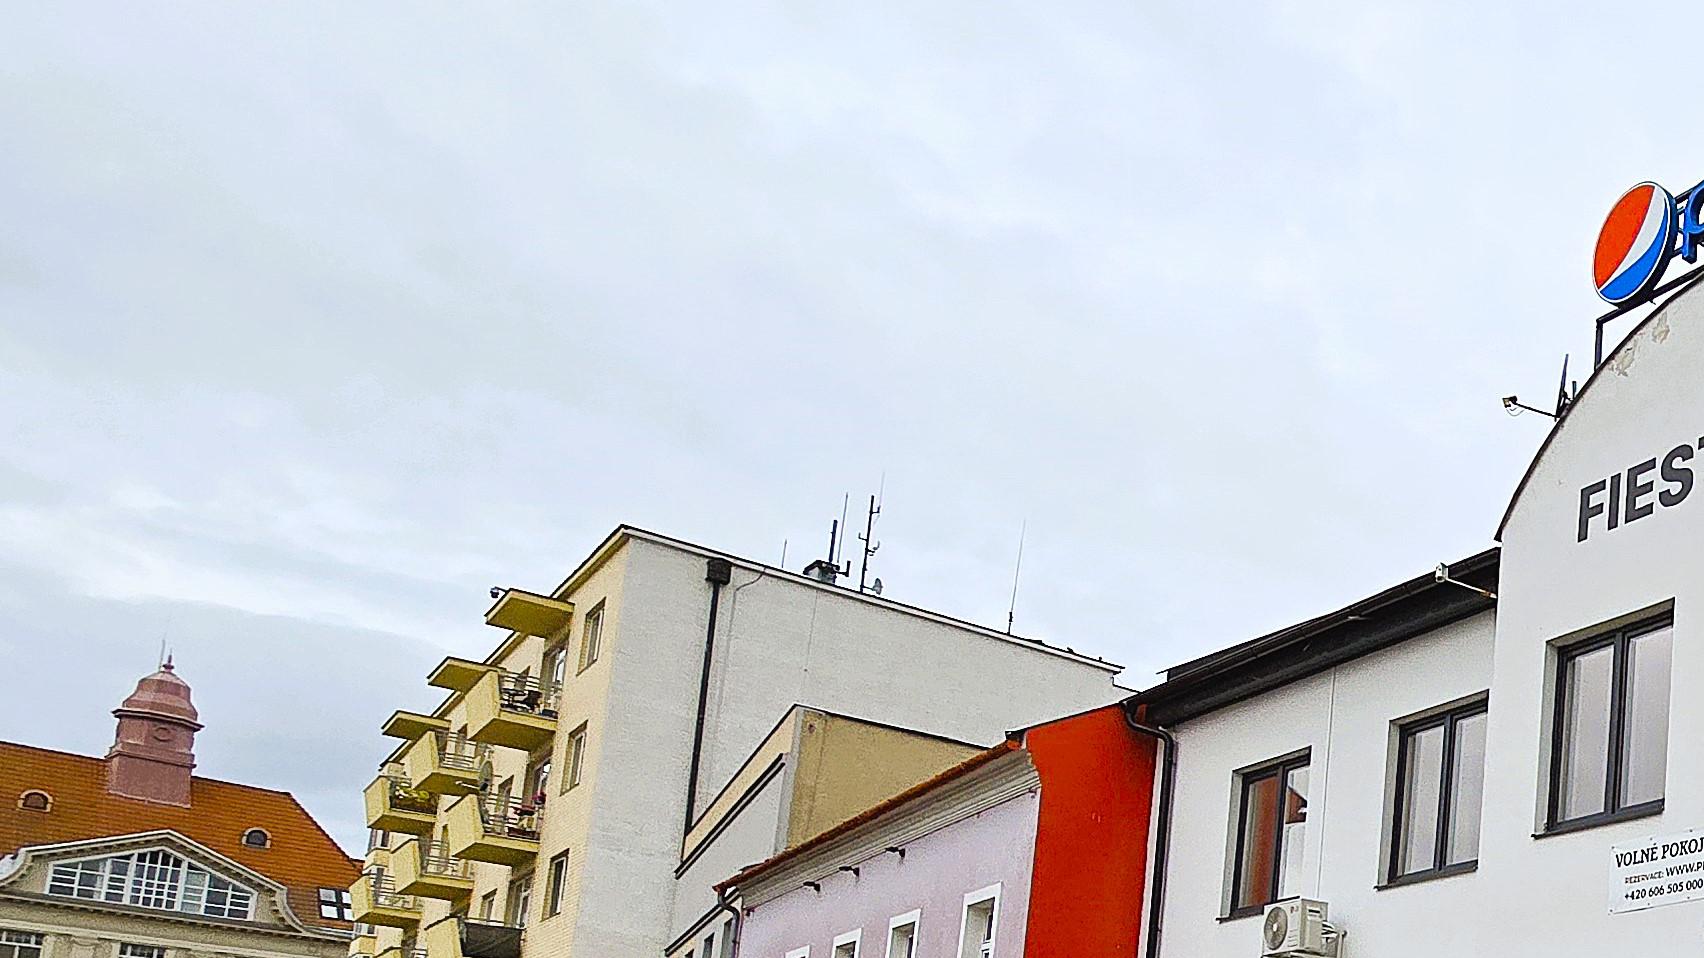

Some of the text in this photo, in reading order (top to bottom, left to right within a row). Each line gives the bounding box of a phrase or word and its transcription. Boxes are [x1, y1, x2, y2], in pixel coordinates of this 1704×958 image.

[1615, 842, 1658, 868] VOLNÉ
[1624, 878, 1704, 901] +420 606 505 000
